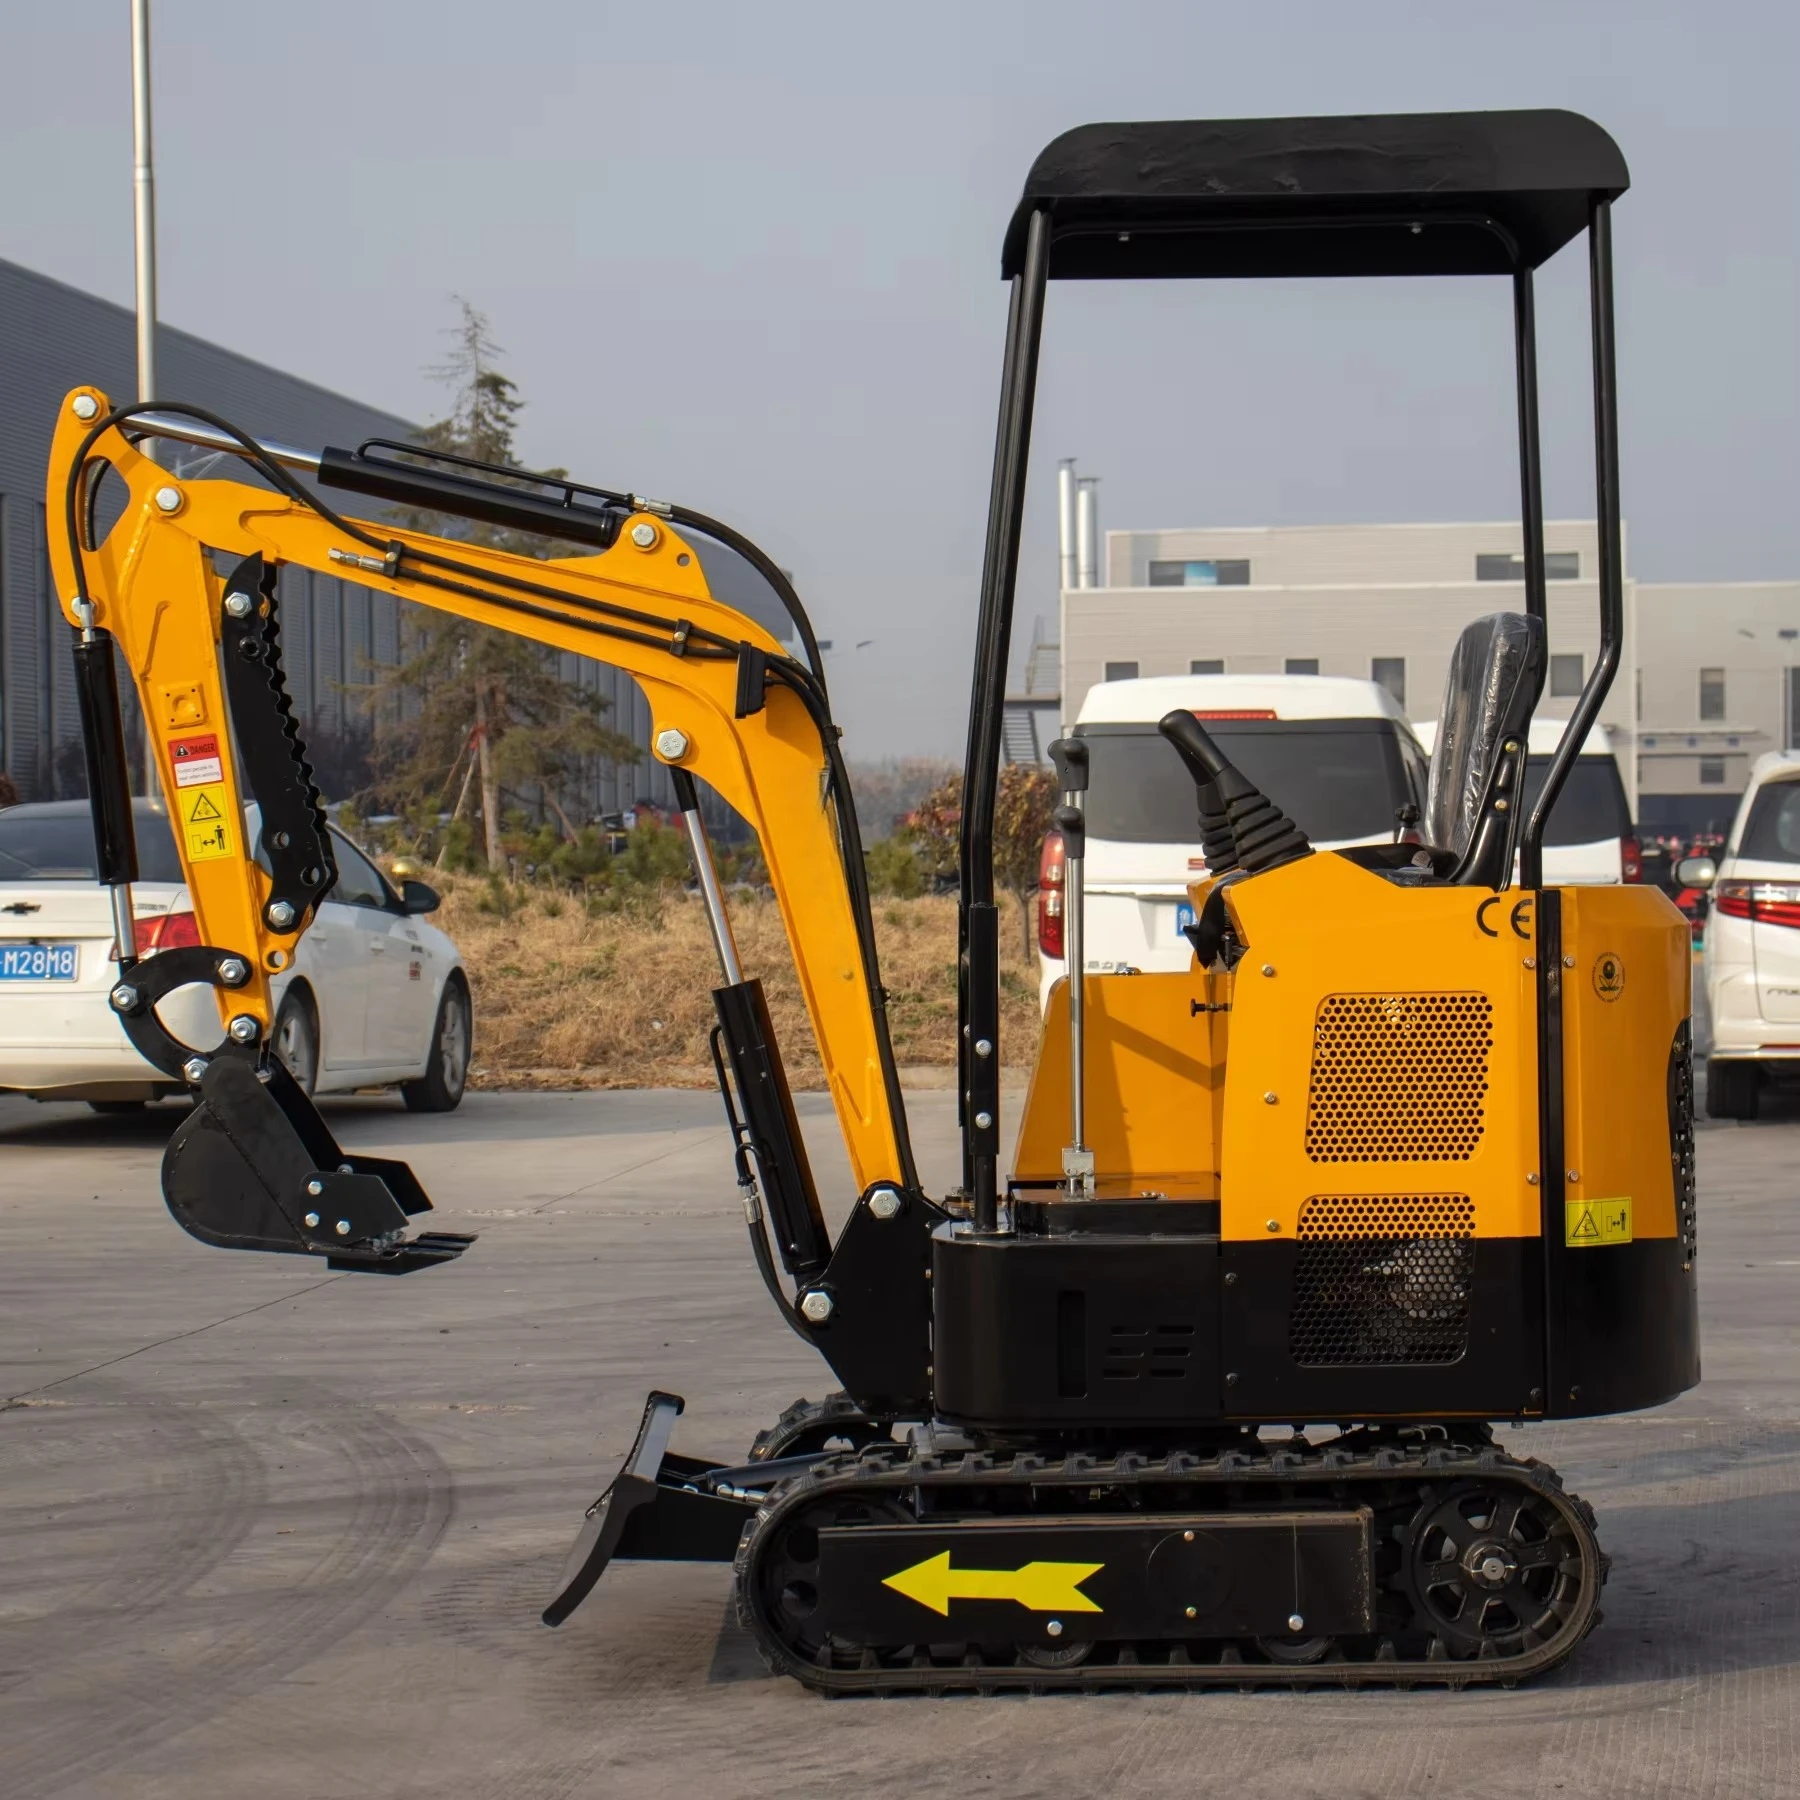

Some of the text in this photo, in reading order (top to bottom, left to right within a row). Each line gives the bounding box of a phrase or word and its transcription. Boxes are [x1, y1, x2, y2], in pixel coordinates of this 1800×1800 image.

[190, 743, 215, 755] DANGER
[1476, 896, 1533, 940] CE
[3, 951, 73, 974] M28M8
